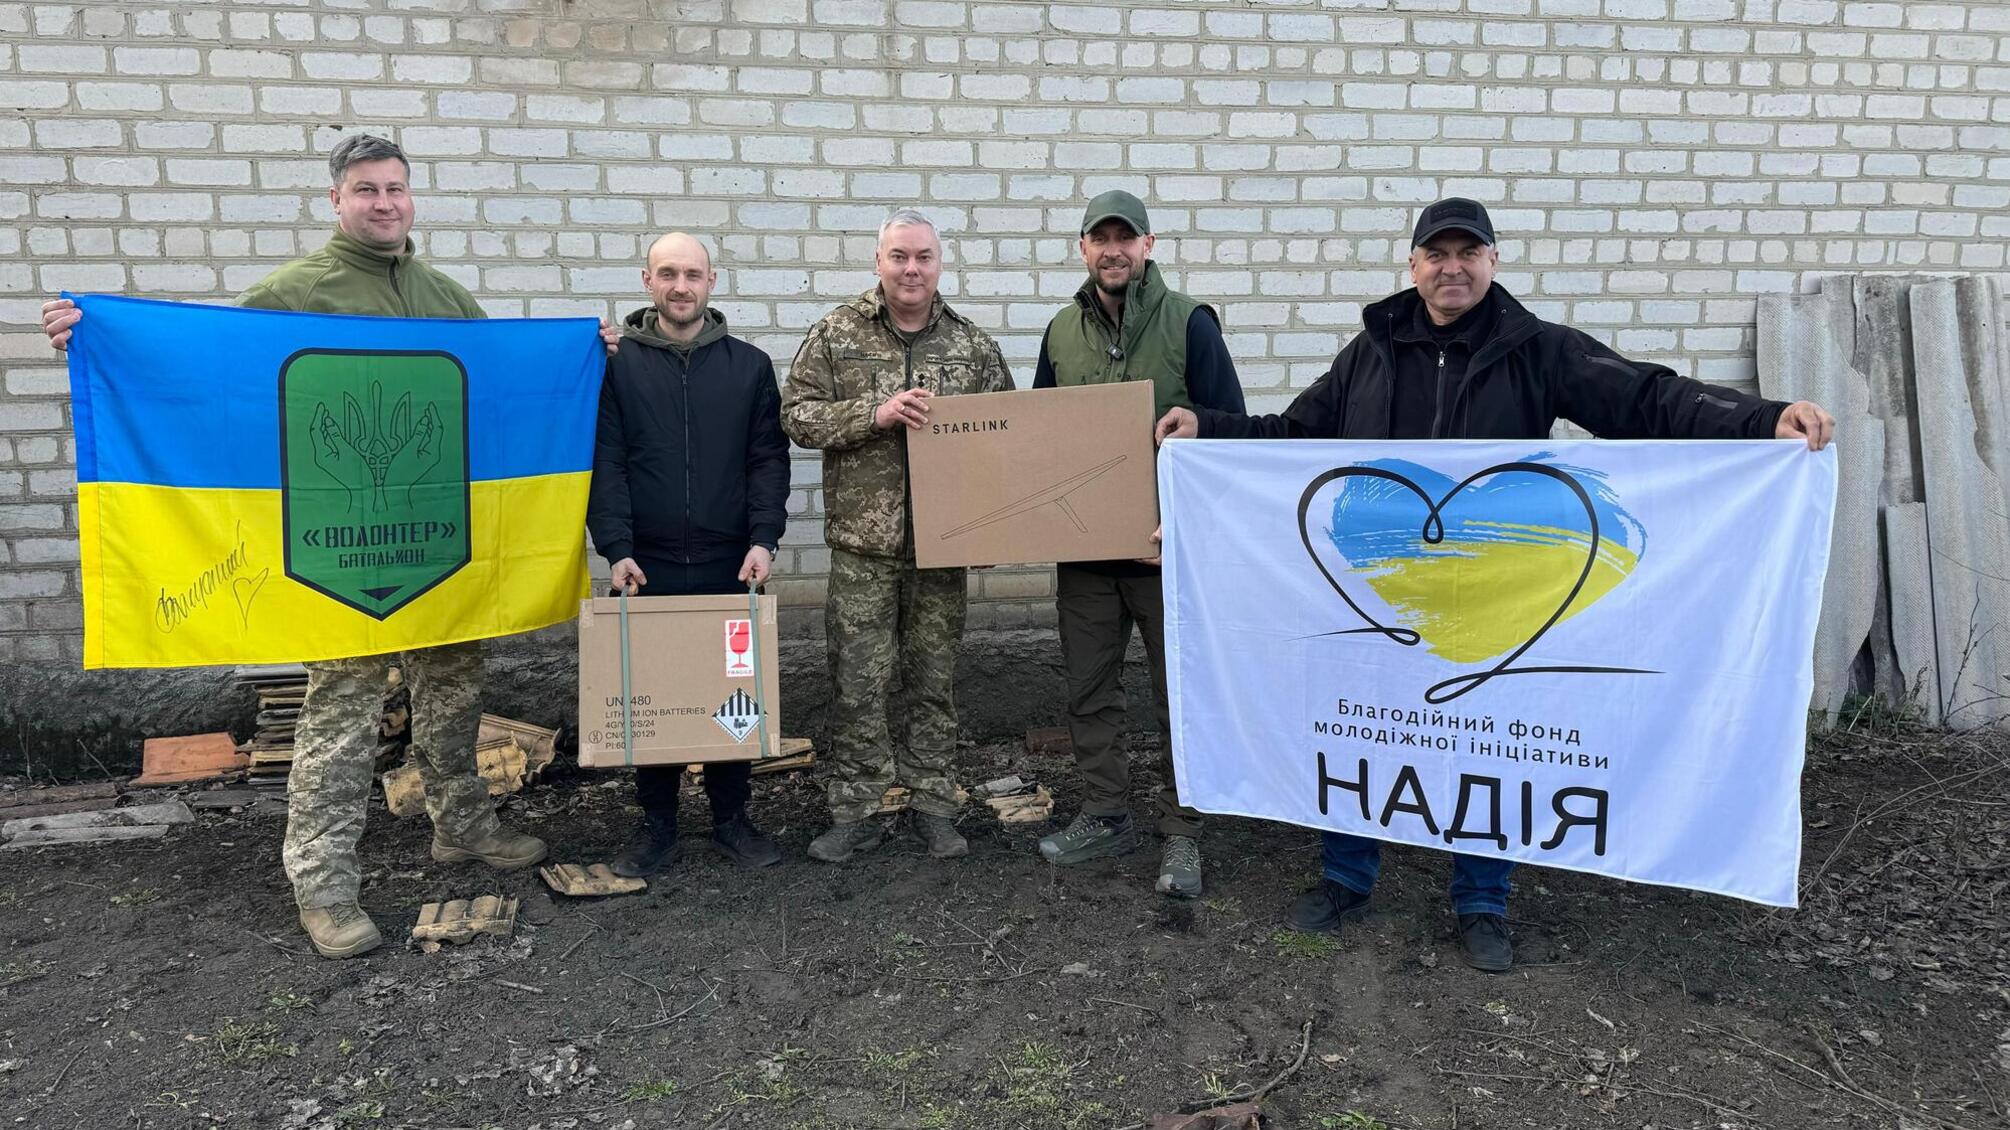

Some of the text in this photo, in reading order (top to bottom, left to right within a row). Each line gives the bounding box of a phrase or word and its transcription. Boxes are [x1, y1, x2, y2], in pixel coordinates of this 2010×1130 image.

[932, 419, 1008, 435] STARLINK
[302, 521, 456, 549] «ВОЛОНТЕР»
[338, 548, 425, 569] БАТАЛЬЙОН
[605, 695, 651, 707] UN480
[605, 707, 706, 719] LITHM ION BATTERIES
[1338, 698, 1580, 746] Благодійний фонд
[605, 720, 655, 729] 4G/Y0/S/24
[605, 730, 656, 740] CN/C30129
[1314, 720, 1609, 770] молодіжної ініціативи
[1317, 751, 1609, 857] НАДІЯ
